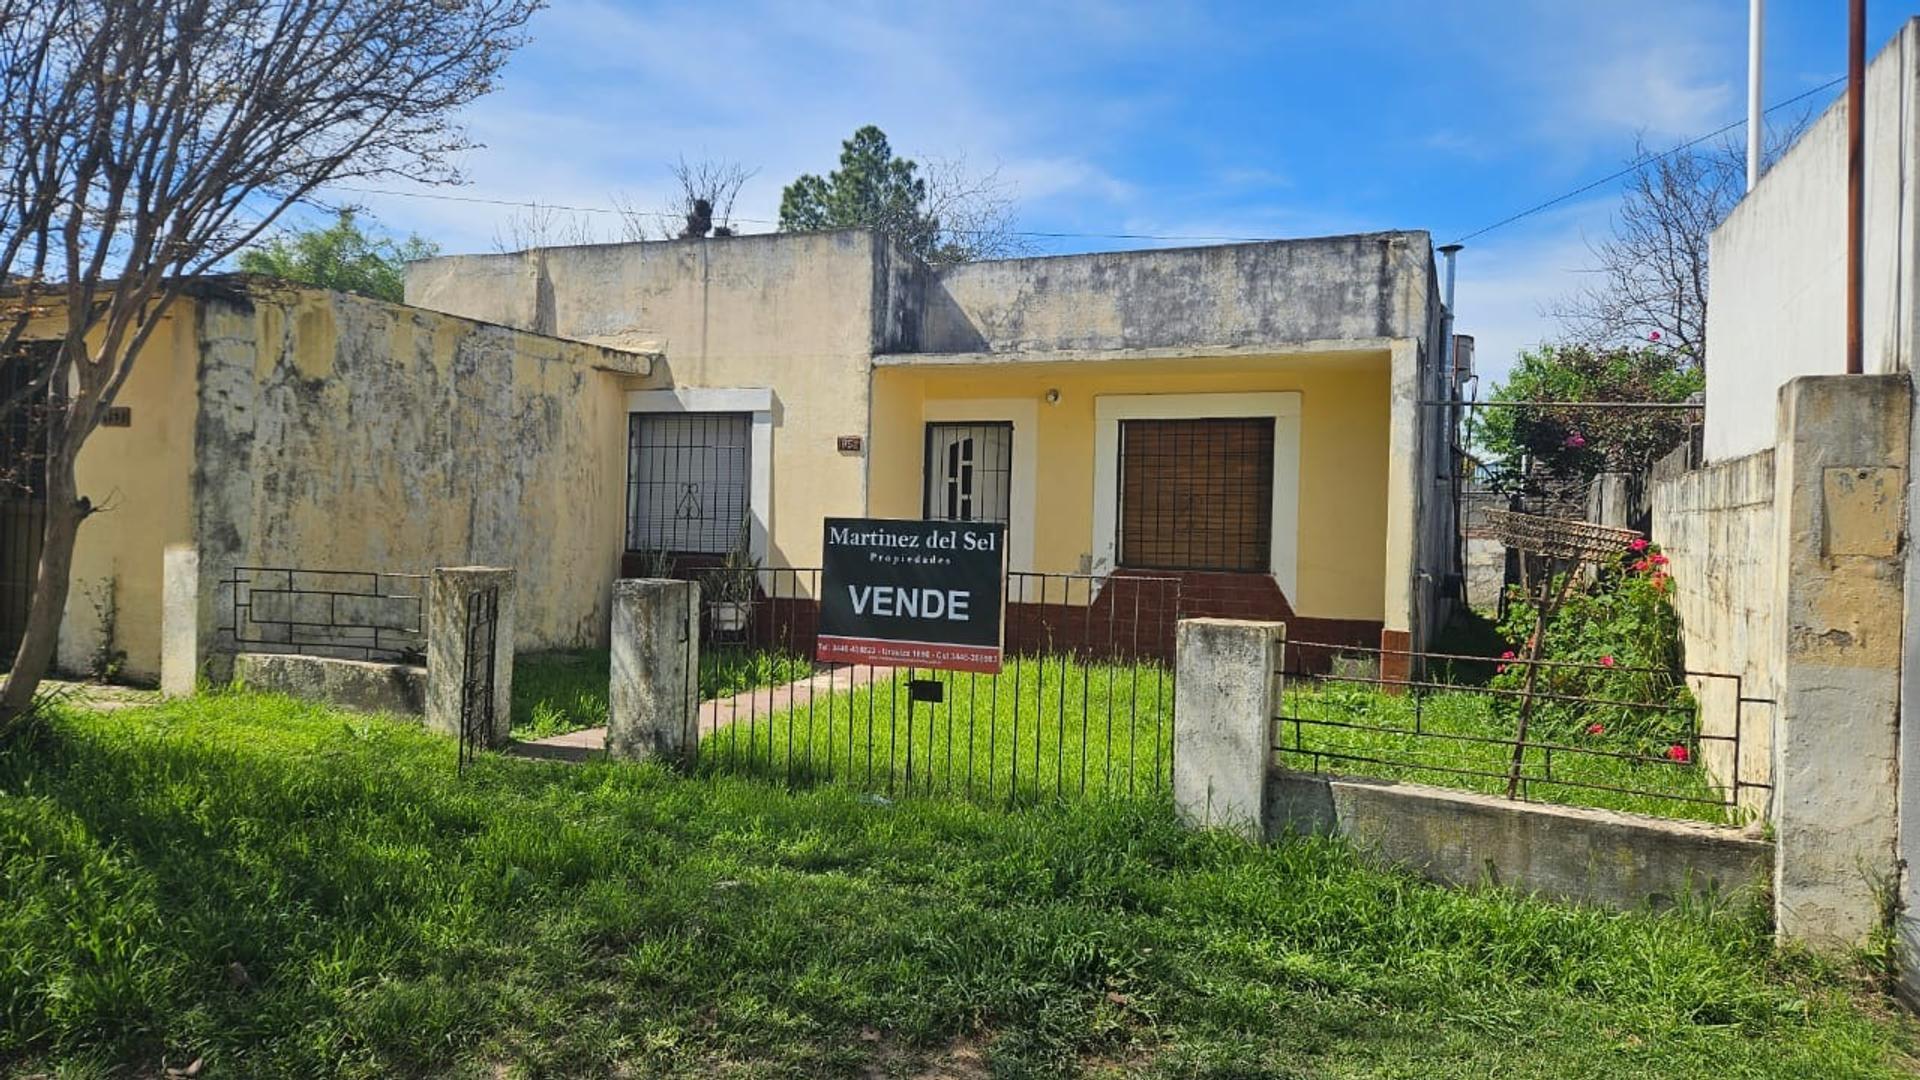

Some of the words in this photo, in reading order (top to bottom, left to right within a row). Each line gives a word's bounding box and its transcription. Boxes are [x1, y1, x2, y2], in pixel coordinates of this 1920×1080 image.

[828, 526, 919, 548] Martinez
[926, 530, 956, 549] del
[963, 531, 995, 551] Sel
[869, 552, 952, 565] Propiedades
[848, 584, 970, 621] VENDE
